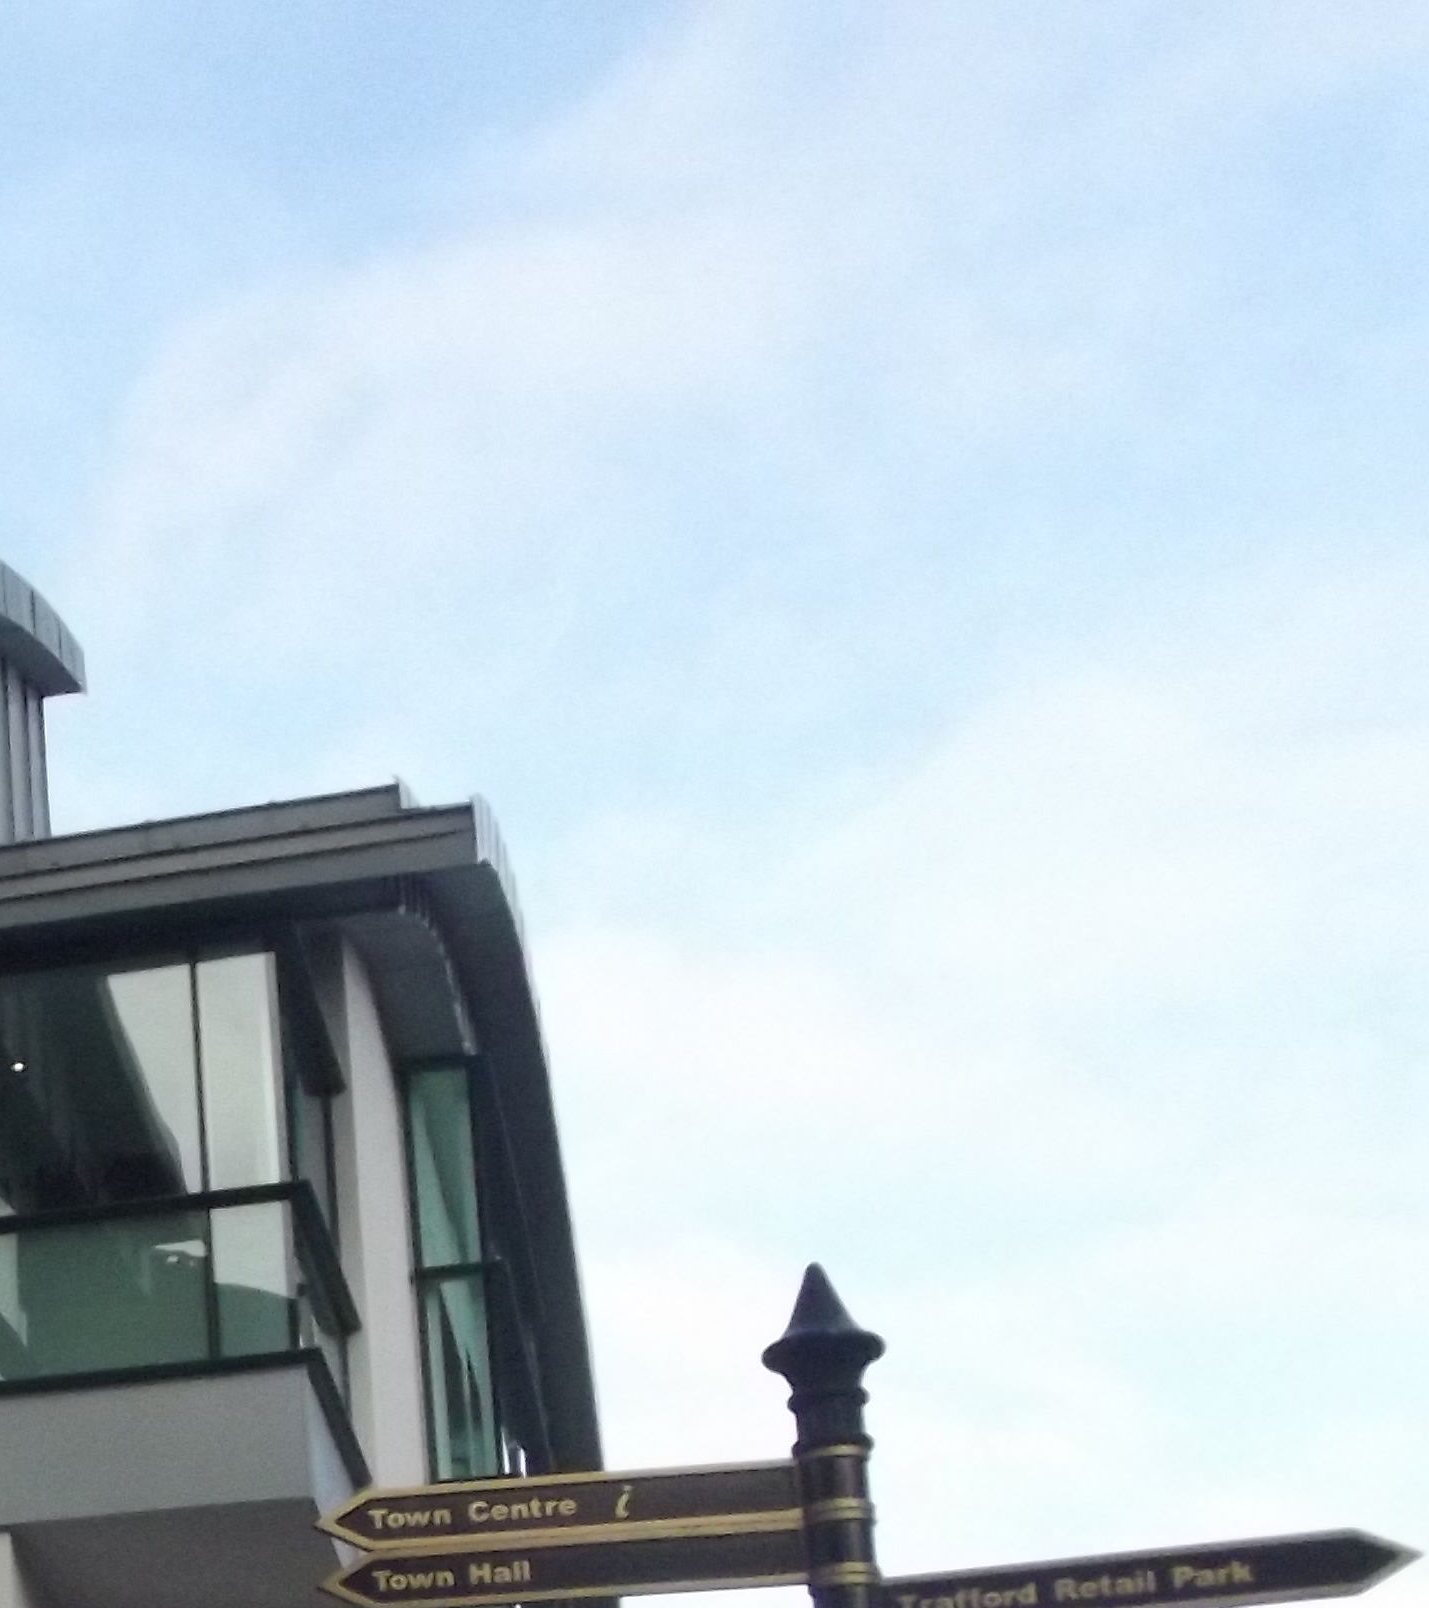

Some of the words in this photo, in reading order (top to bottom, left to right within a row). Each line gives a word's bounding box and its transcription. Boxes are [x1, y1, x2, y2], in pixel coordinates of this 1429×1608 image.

[368, 1506, 452, 1530] Town
[467, 1497, 578, 1523] Centre
[371, 1569, 455, 1592] Town
[468, 1559, 531, 1584] Hall
[1053, 1570, 1157, 1601] Retail
[1171, 1559, 1254, 1589] Park
